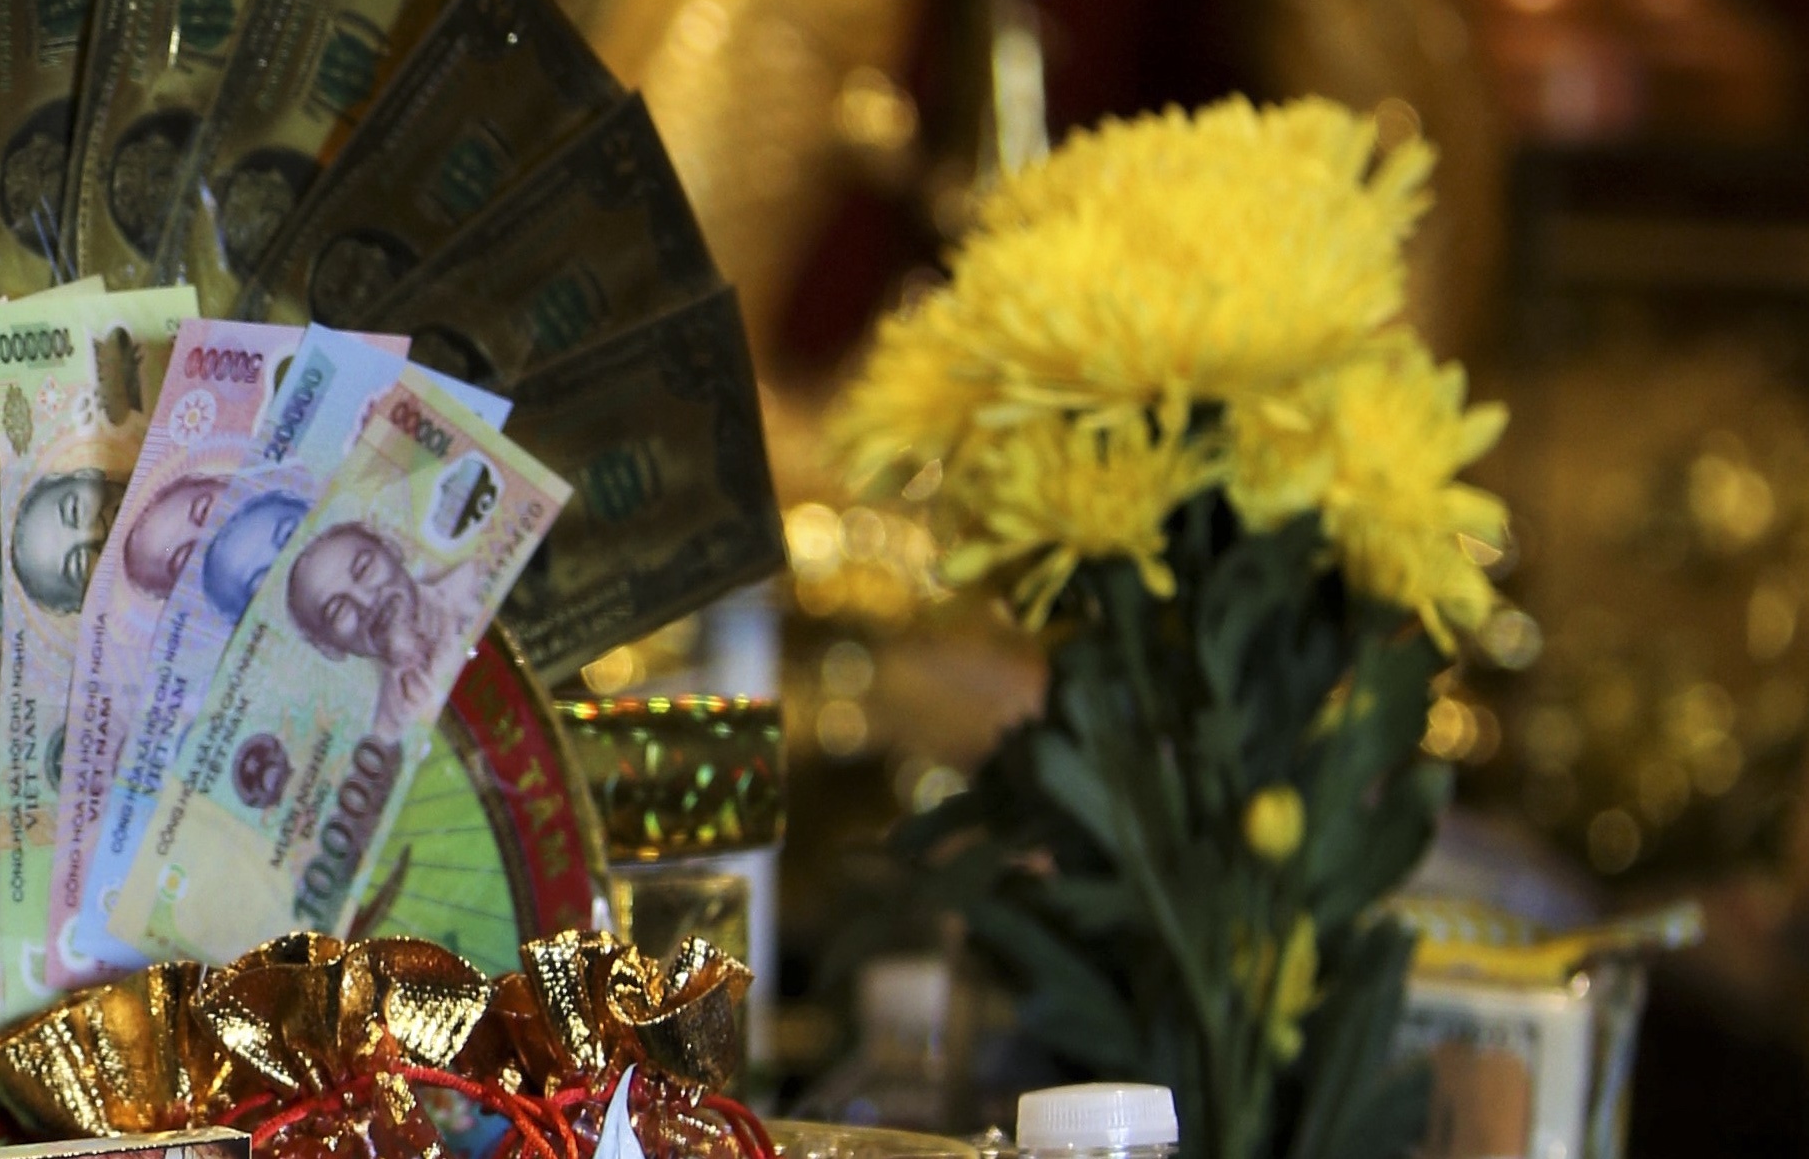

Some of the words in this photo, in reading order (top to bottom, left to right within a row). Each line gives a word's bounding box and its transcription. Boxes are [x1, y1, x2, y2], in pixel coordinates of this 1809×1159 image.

[184, 346, 263, 383] 50000
[263, 367, 323, 463] 20000
[23, 697, 37, 760] NAM
[91, 695, 114, 756] NAM
[157, 674, 190, 737] NAM
[219, 694, 251, 744] NAM
[294, 737, 383, 925] 10000
